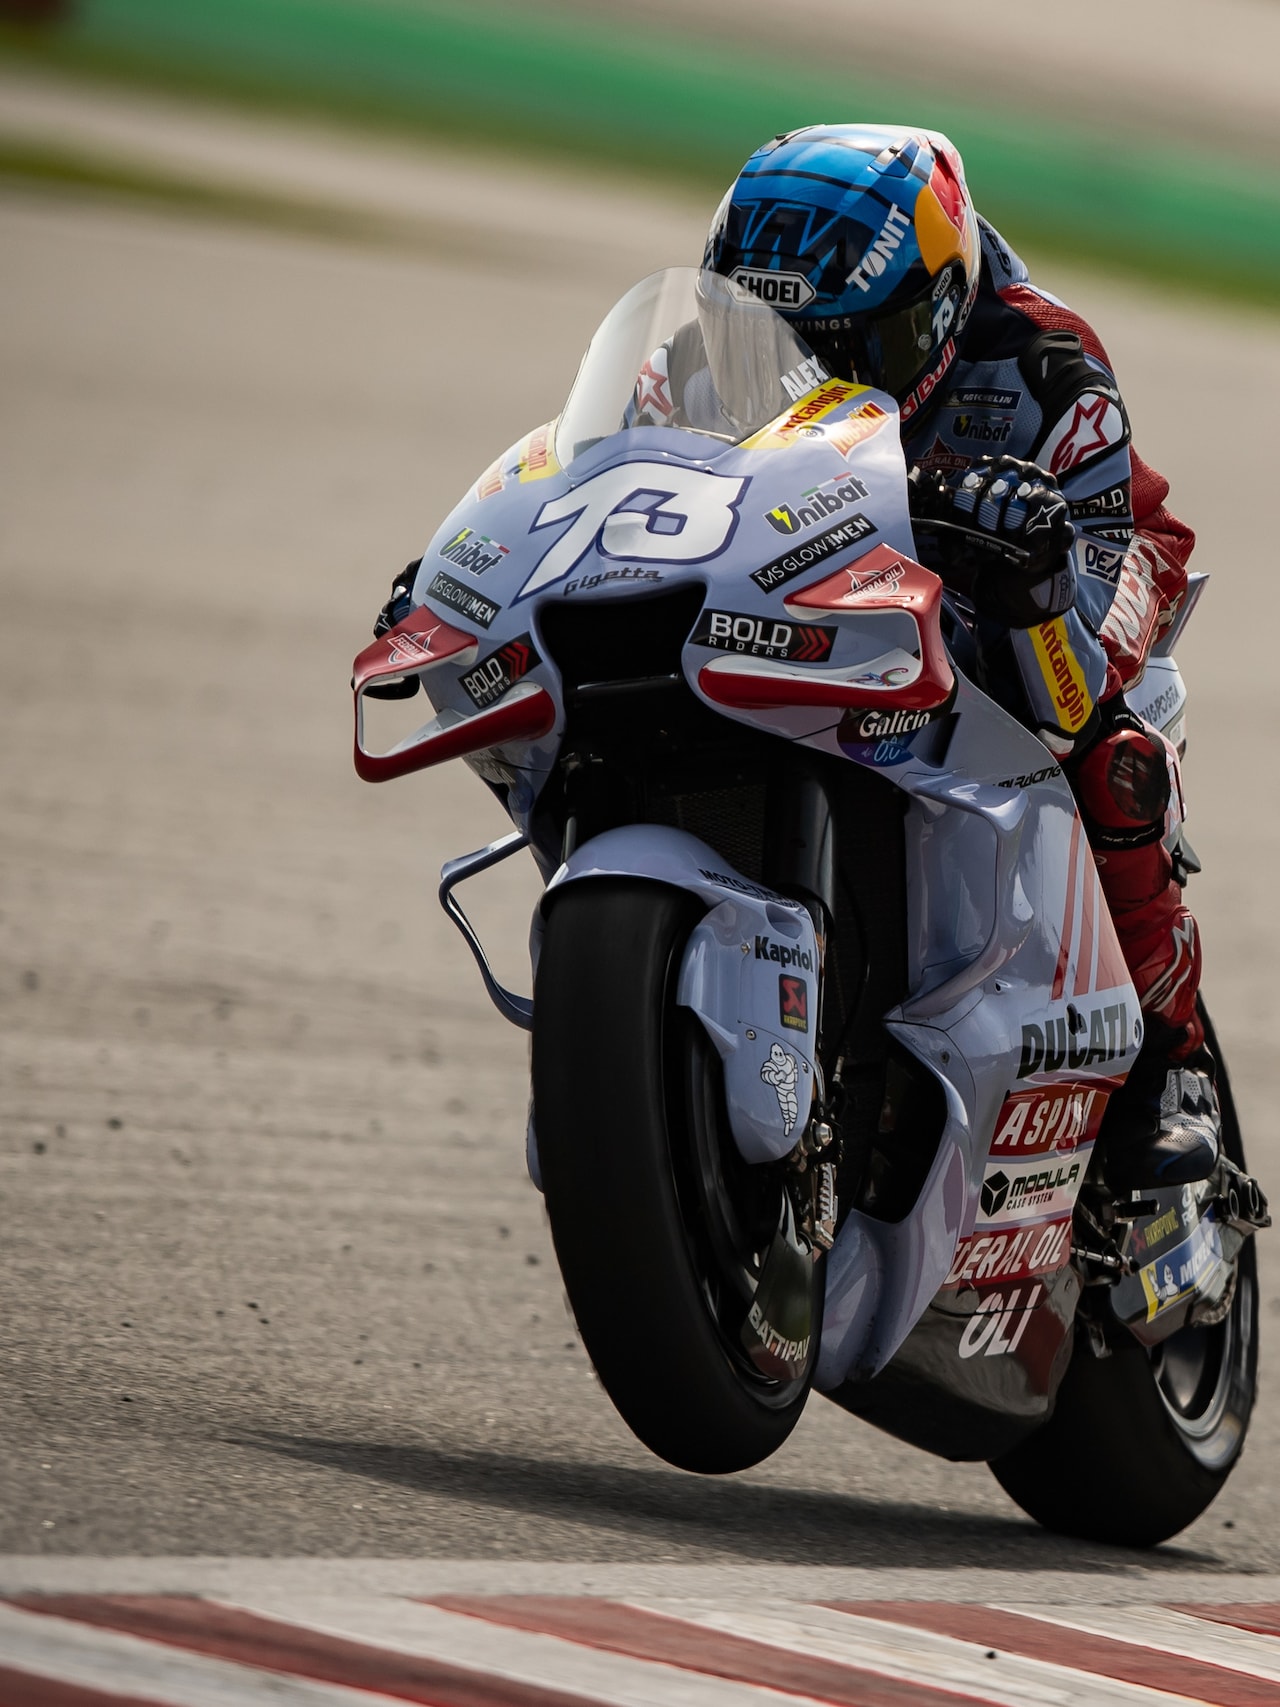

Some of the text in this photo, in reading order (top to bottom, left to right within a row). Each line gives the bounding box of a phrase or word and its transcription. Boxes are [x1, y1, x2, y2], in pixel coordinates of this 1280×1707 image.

[846, 203, 911, 292] TONIT
[736, 275, 801, 304] SHOEI
[780, 354, 829, 402] ALEX
[916, 336, 957, 406] Bull
[961, 393, 1014, 405] MICHELIN
[953, 413, 1012, 442] Unibat
[763, 474, 872, 536] Unibat
[438, 526, 504, 577] Unibat
[508, 459, 753, 609] 73
[754, 569, 785, 588] MS
[782, 538, 829, 572] GLOW
[833, 517, 871, 547] MEN
[563, 567, 664, 597] Gigetta
[884, 568, 901, 582] OIL
[442, 583, 472, 607] GLOW
[469, 599, 496, 624] MEN
[708, 636, 789, 659] RIDERS
[709, 612, 793, 648] BOLD
[463, 657, 505, 698] BOLD
[1015, 765, 1061, 788] RACING
[754, 935, 815, 973] Kapriol
[1016, 1002, 1127, 1080] DUCATI
[1006, 1191, 1055, 1211] CASE SYSTEM
[1009, 1163, 1080, 1198] MODULA
[1028, 1219, 1073, 1270] OIL
[958, 1284, 1042, 1359] OLI
